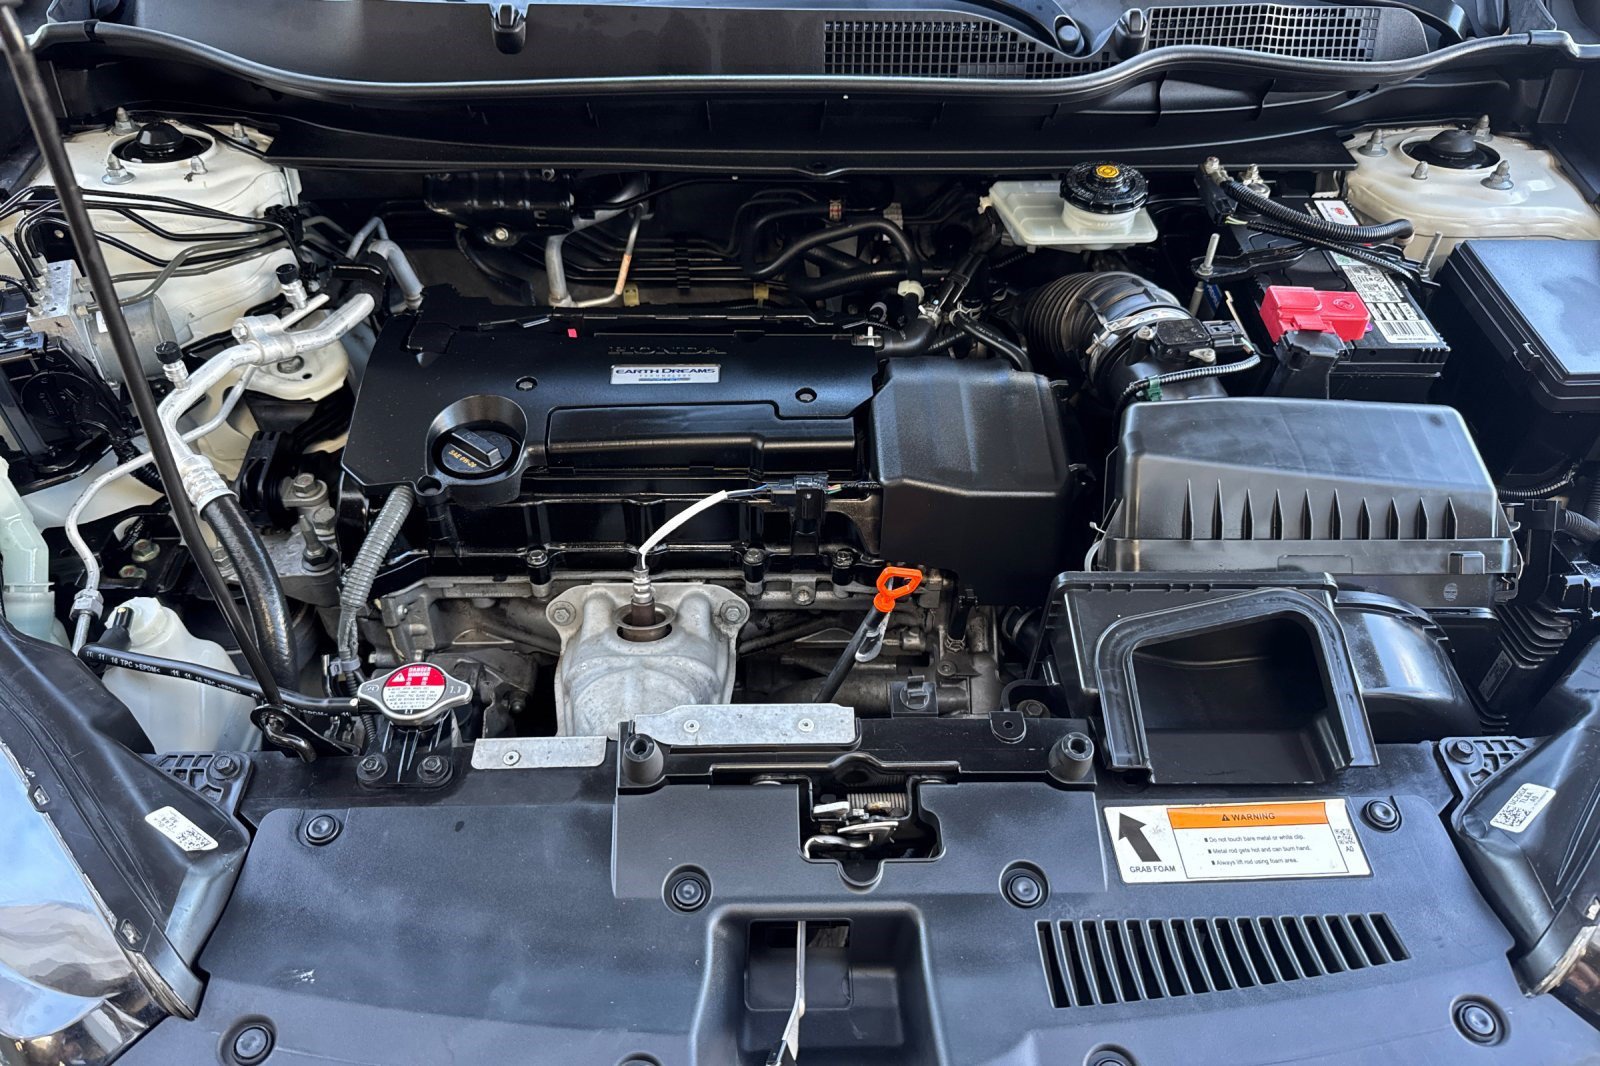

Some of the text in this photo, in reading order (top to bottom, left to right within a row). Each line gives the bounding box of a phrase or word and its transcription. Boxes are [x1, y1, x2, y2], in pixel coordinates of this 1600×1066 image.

[448, 450, 462, 459] SAE
[120, 658, 133, 668] TPC
[1231, 813, 1276, 821] WARNING
[1129, 865, 1176, 873] GRAB FOAM
